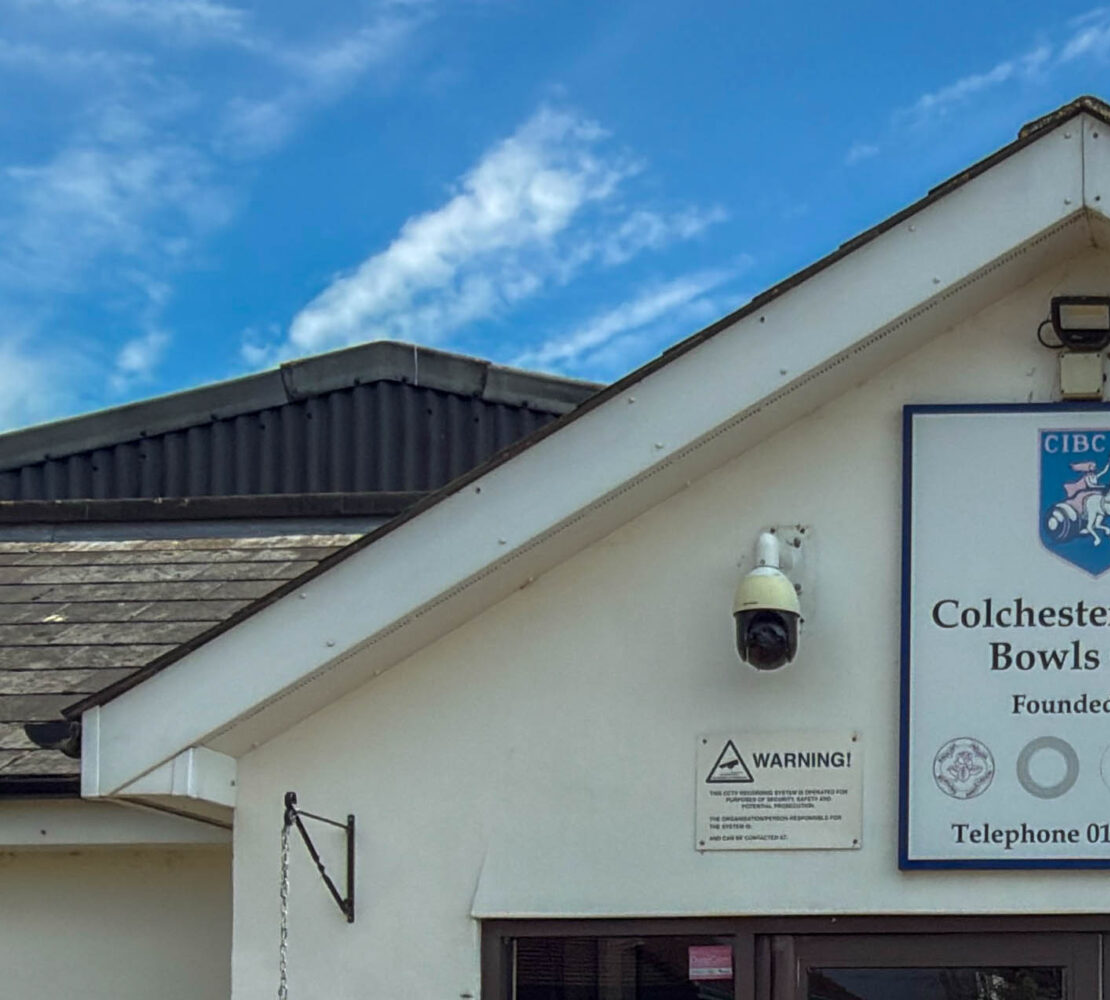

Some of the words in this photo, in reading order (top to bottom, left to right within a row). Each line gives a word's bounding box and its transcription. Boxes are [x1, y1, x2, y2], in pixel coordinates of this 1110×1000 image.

[1044, 434, 1106, 454] CIBC
[989, 641, 1100, 671] Bowls
[752, 752, 851, 768] WARNING!
[951, 824, 1079, 849] Telephone
